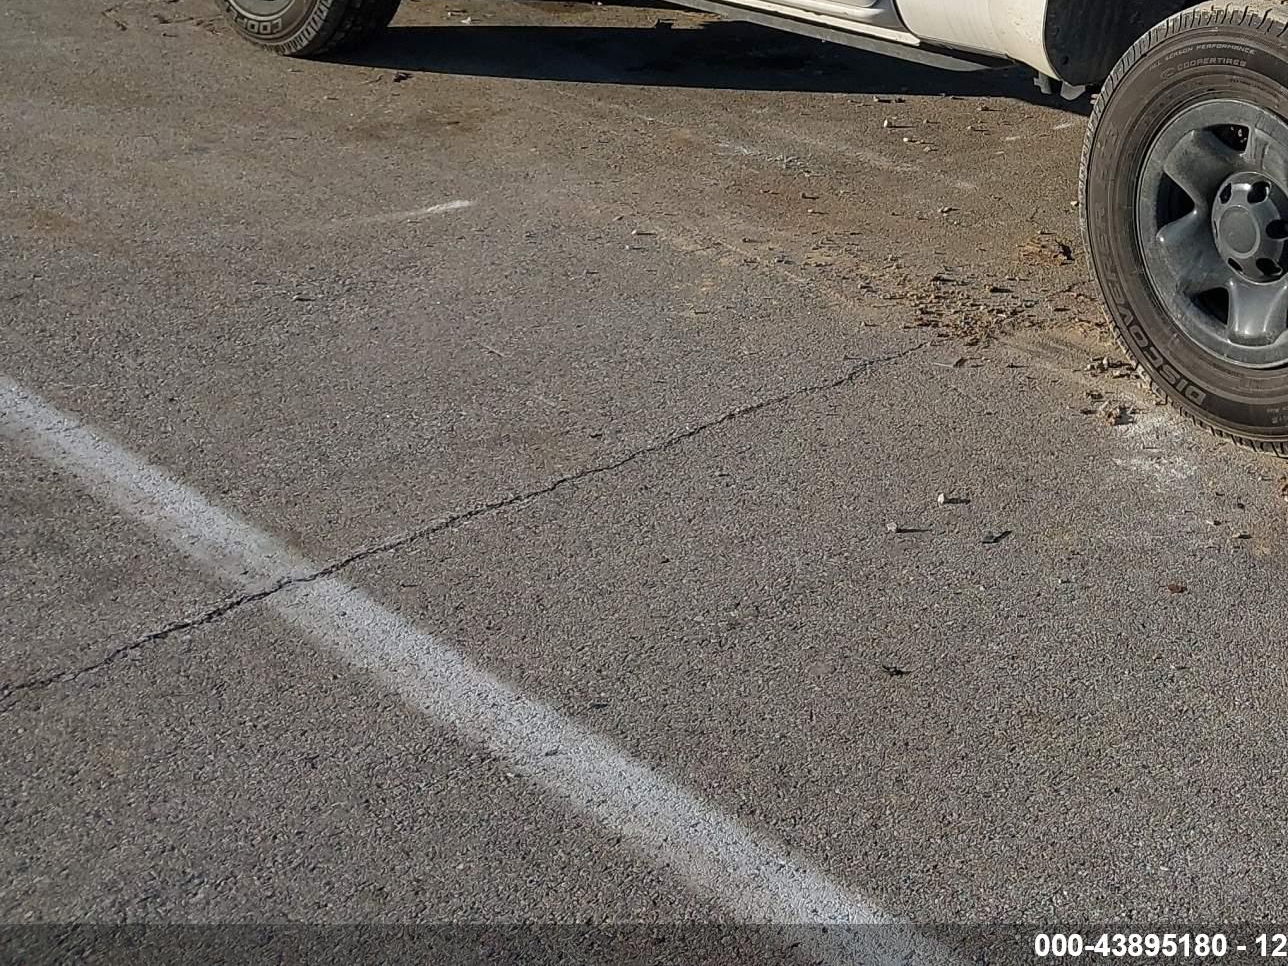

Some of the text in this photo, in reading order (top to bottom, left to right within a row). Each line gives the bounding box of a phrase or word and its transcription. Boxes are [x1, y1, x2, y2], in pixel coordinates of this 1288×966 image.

[1165, 46, 1194, 61] SEASON
[1195, 42, 1257, 54] PERFORMANCE
[1176, 57, 1248, 72] COOPERTIRES
